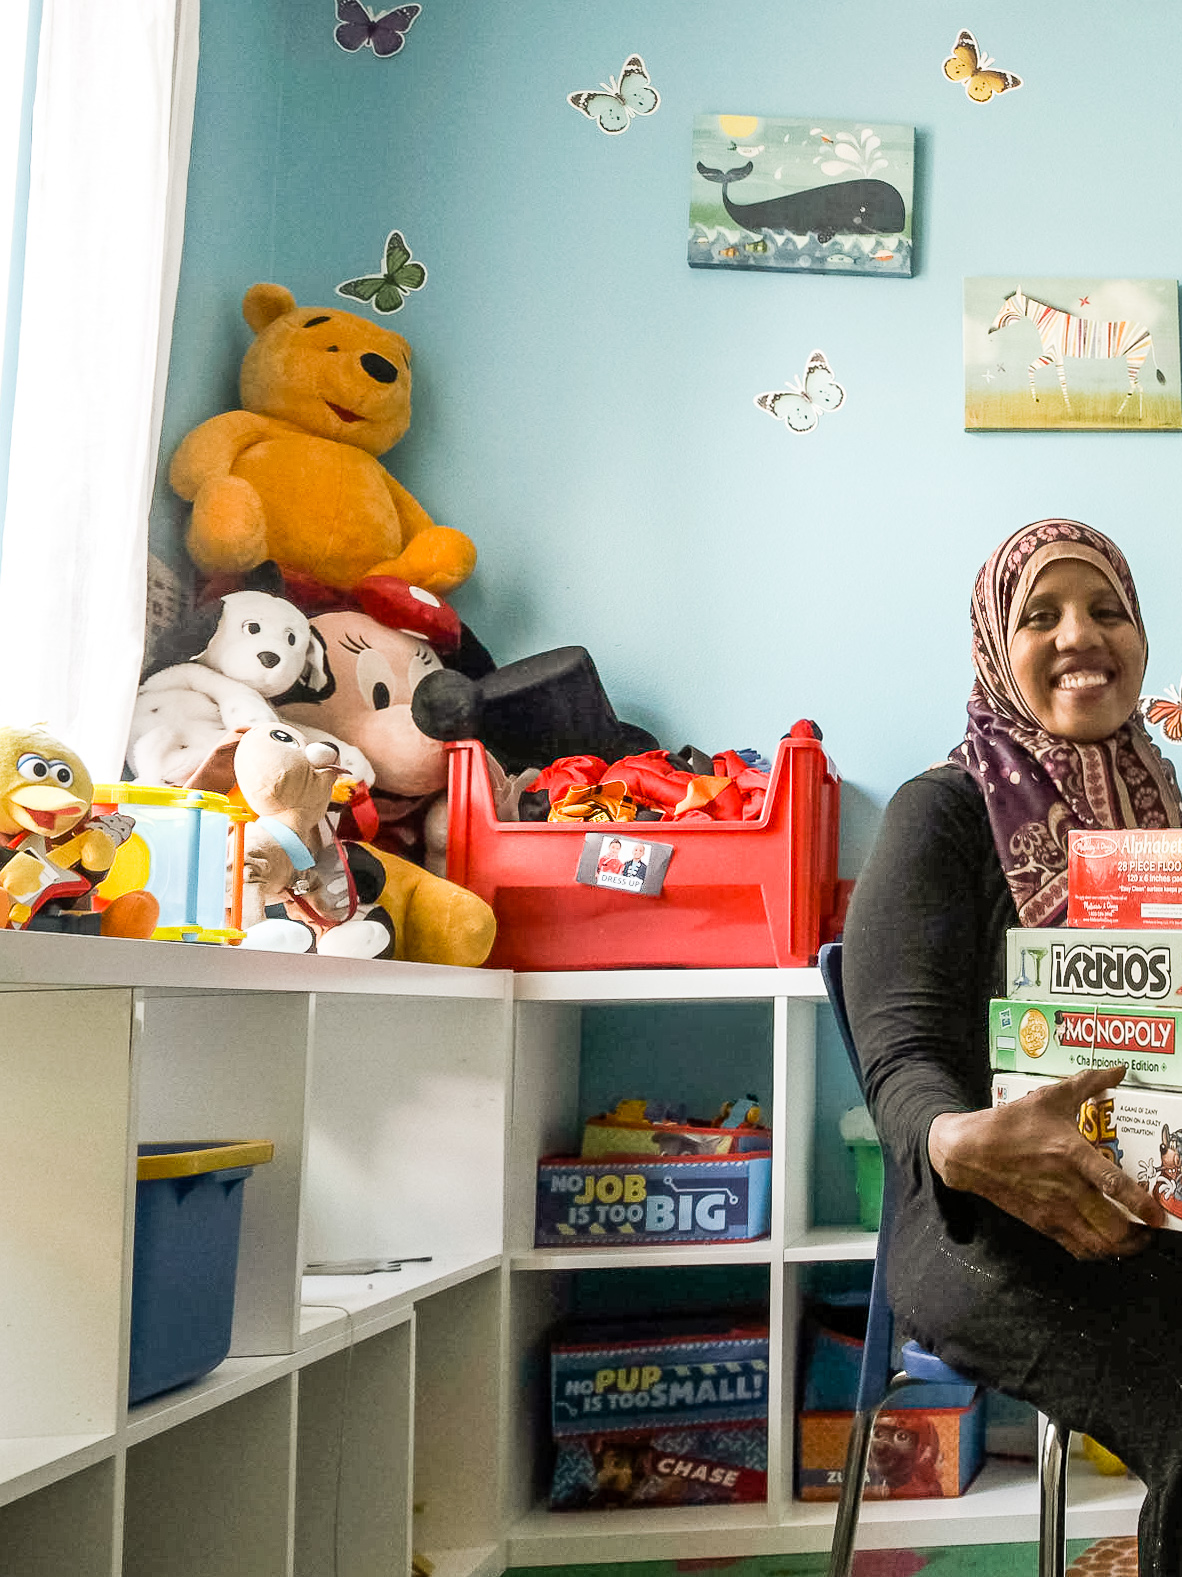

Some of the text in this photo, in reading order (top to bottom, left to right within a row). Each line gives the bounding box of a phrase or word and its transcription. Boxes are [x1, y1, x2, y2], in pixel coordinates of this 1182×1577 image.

[601, 874, 626, 885] DRESS
[1118, 861, 1128, 872] 28
[1130, 861, 1156, 872] PIECE
[1149, 874, 1171, 883] inches
[1052, 947, 1168, 996] SORRY!
[1065, 1016, 1172, 1048] MONOPOLY
[1131, 1059, 1159, 1072] Edition
[574, 1174, 647, 1204] JOB
[568, 1193, 726, 1232] IS TOO BIG
[582, 1374, 764, 1412] IS TOO SMALL!
[594, 1365, 662, 1394] PUP
[657, 1458, 741, 1487] CHASE
